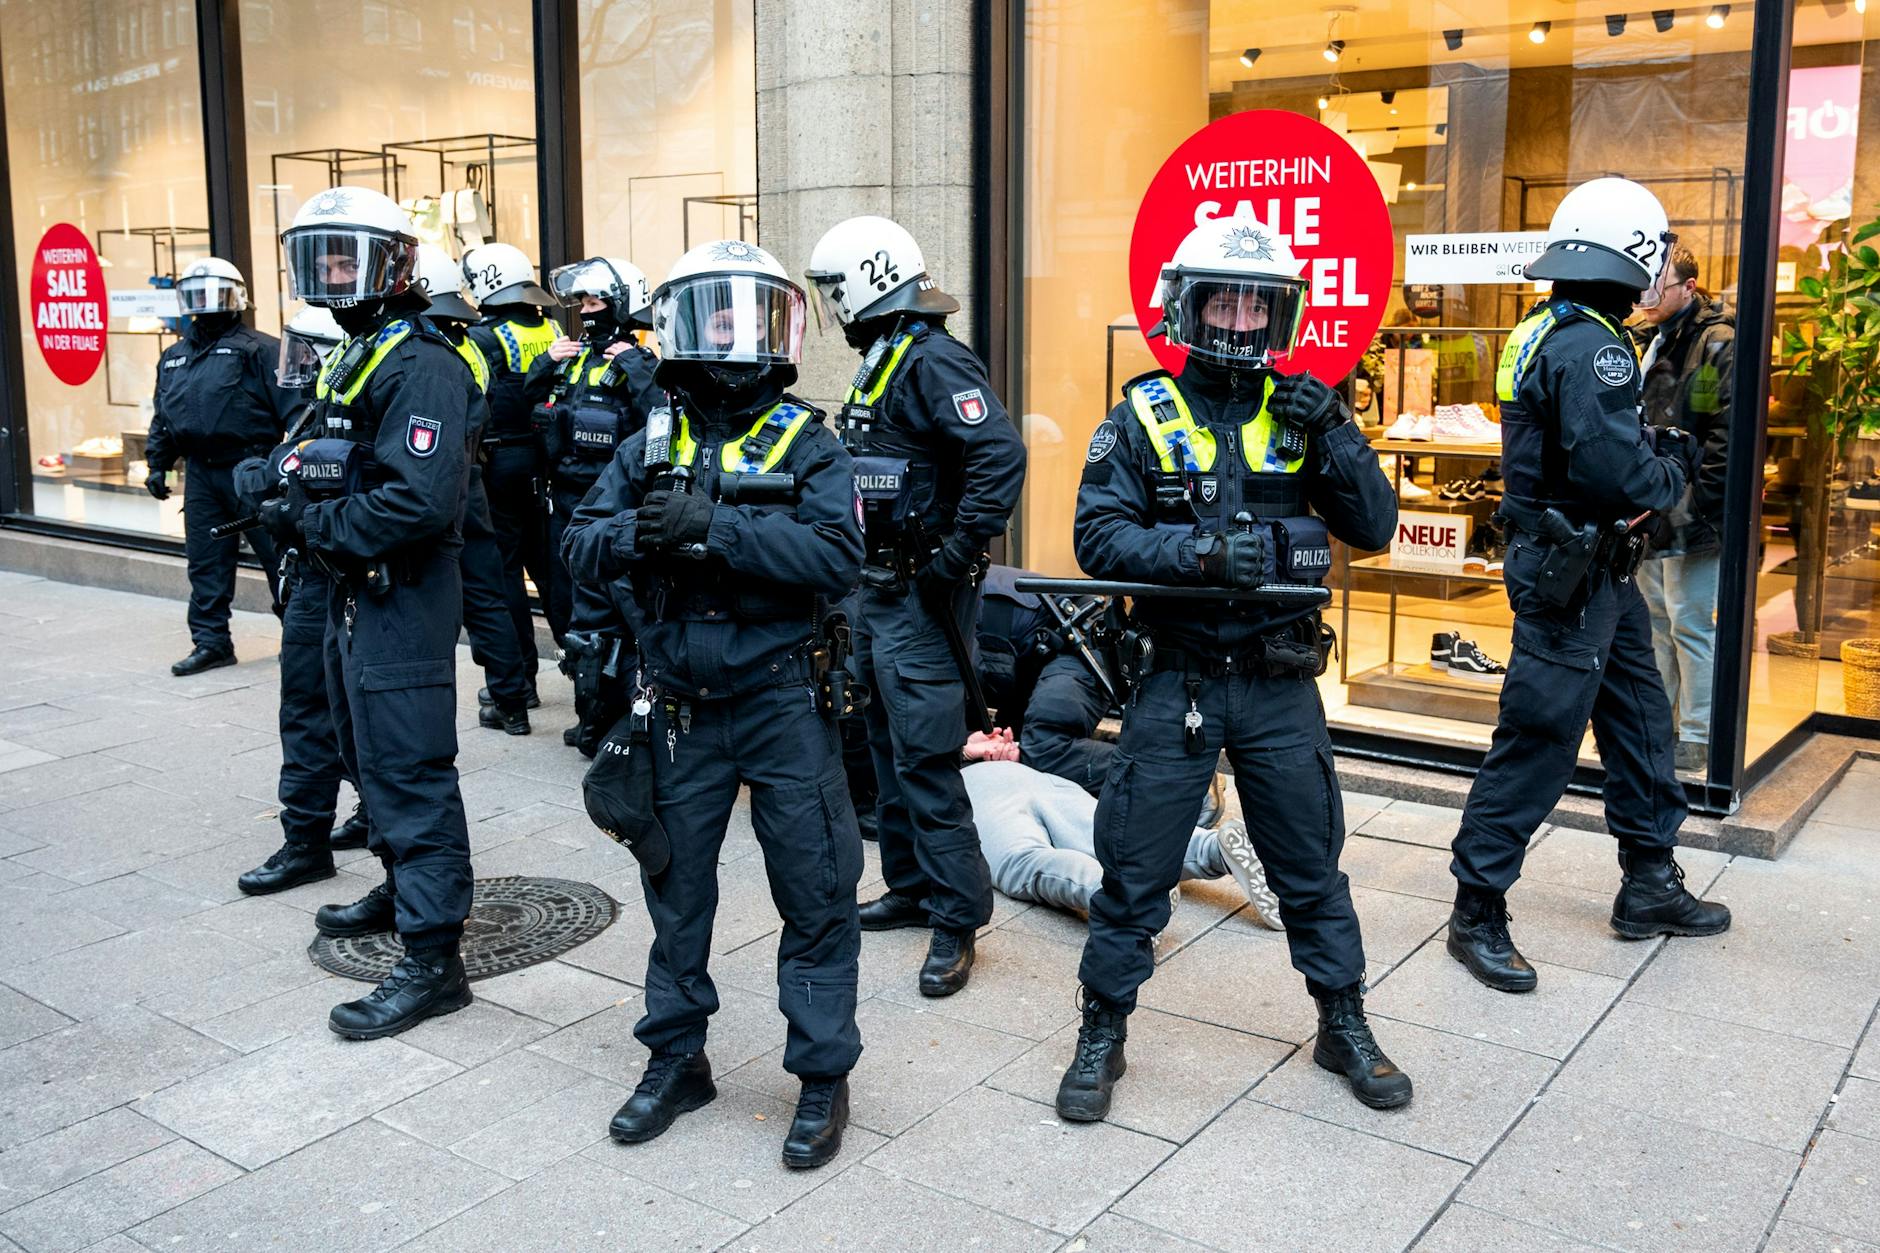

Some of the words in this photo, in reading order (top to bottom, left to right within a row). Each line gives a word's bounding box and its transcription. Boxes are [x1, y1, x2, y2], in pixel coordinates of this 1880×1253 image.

[1185, 155, 1331, 190] WEITERHIN
[42, 248, 88, 264] WEITERHIN
[1411, 244, 1439, 256] WIR
[1442, 242, 1498, 255] BLEIBEN
[1623, 230, 1657, 268] 22
[479, 264, 502, 286] 22
[860, 249, 898, 286] 22
[46, 269, 87, 297] SALE
[37, 302, 104, 330] ARTIKEL
[43, 335, 53, 349] IN
[55, 335, 71, 350] DER
[72, 335, 99, 351] FILIALE
[522, 340, 553, 358] POLIZE
[1213, 339, 1253, 357] POLIZEI
[955, 391, 980, 402] POLIZEI
[411, 418, 440, 430] POLIZEI
[574, 431, 613, 444] POLIZEI
[303, 463, 342, 478] POLIZEI
[1399, 524, 1456, 548] NEUE
[1398, 544, 1456, 559] KOLLEKTION
